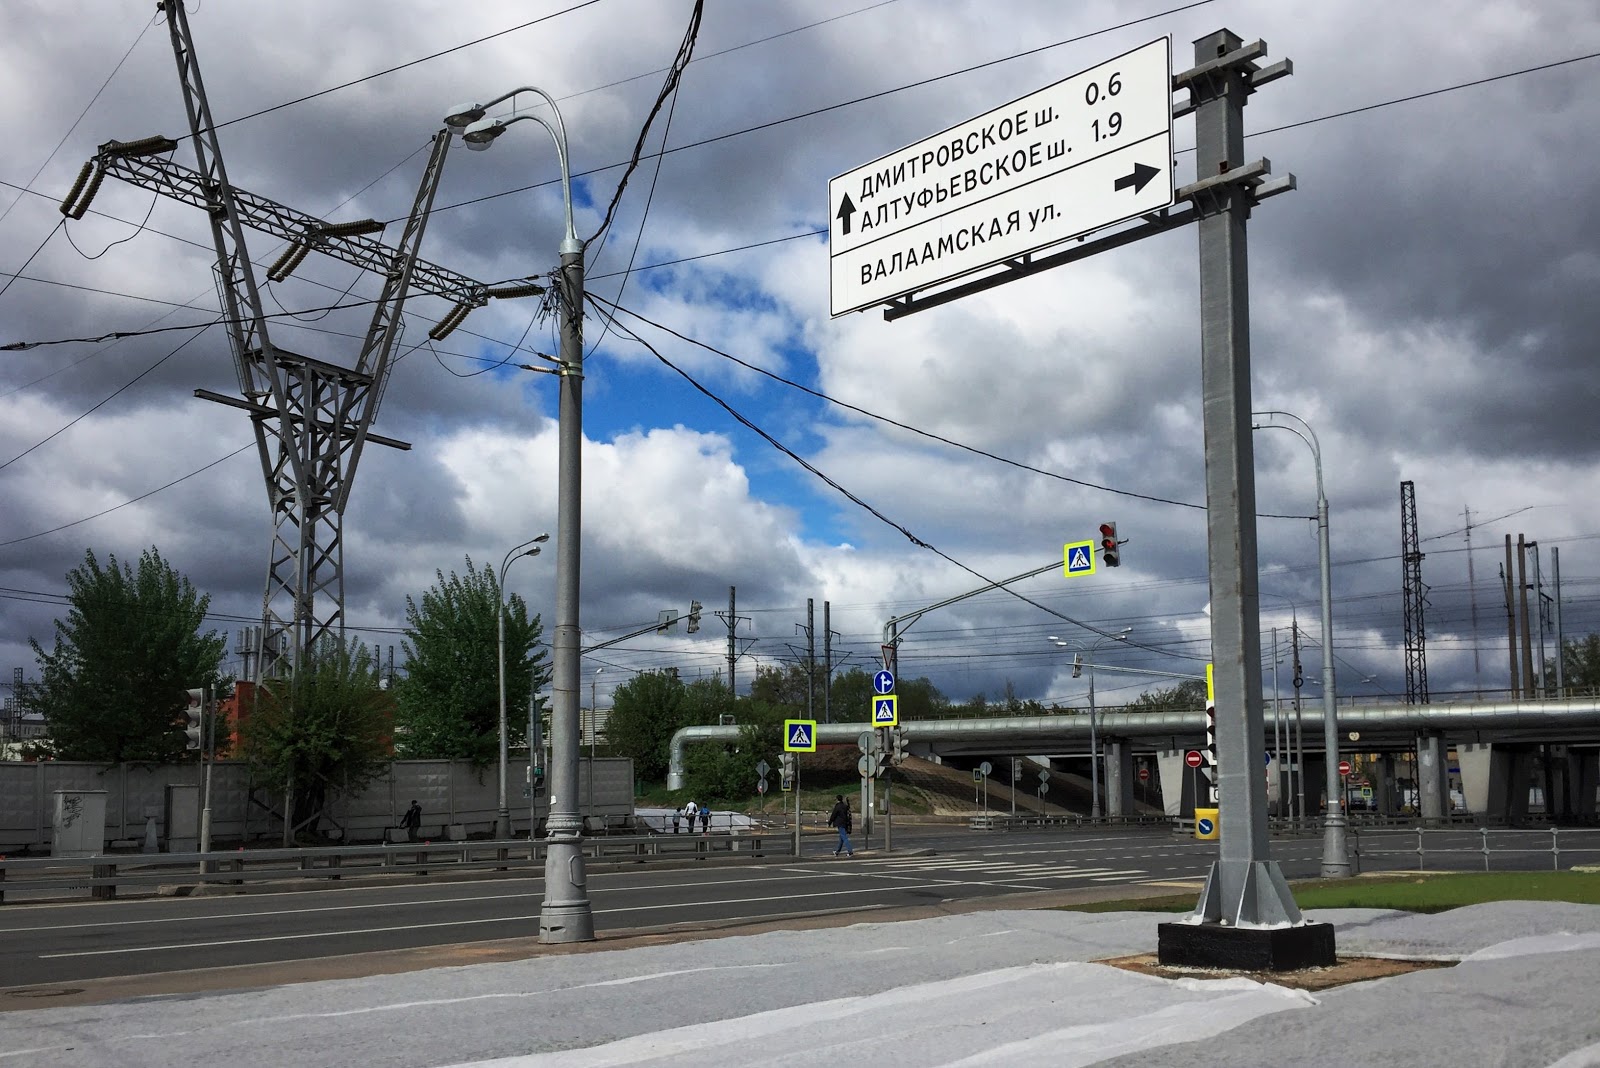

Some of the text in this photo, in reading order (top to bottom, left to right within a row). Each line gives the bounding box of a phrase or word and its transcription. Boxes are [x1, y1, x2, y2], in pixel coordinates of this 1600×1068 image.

[860, 72, 1122, 202] ДМИТРОВСКОЕ ш. 0.6
[860, 111, 1122, 233] АЛТУФЬЕВСКОЕ ш. 1.9
[861, 204, 1062, 285] ВАЛААМСКАЯ ул.
